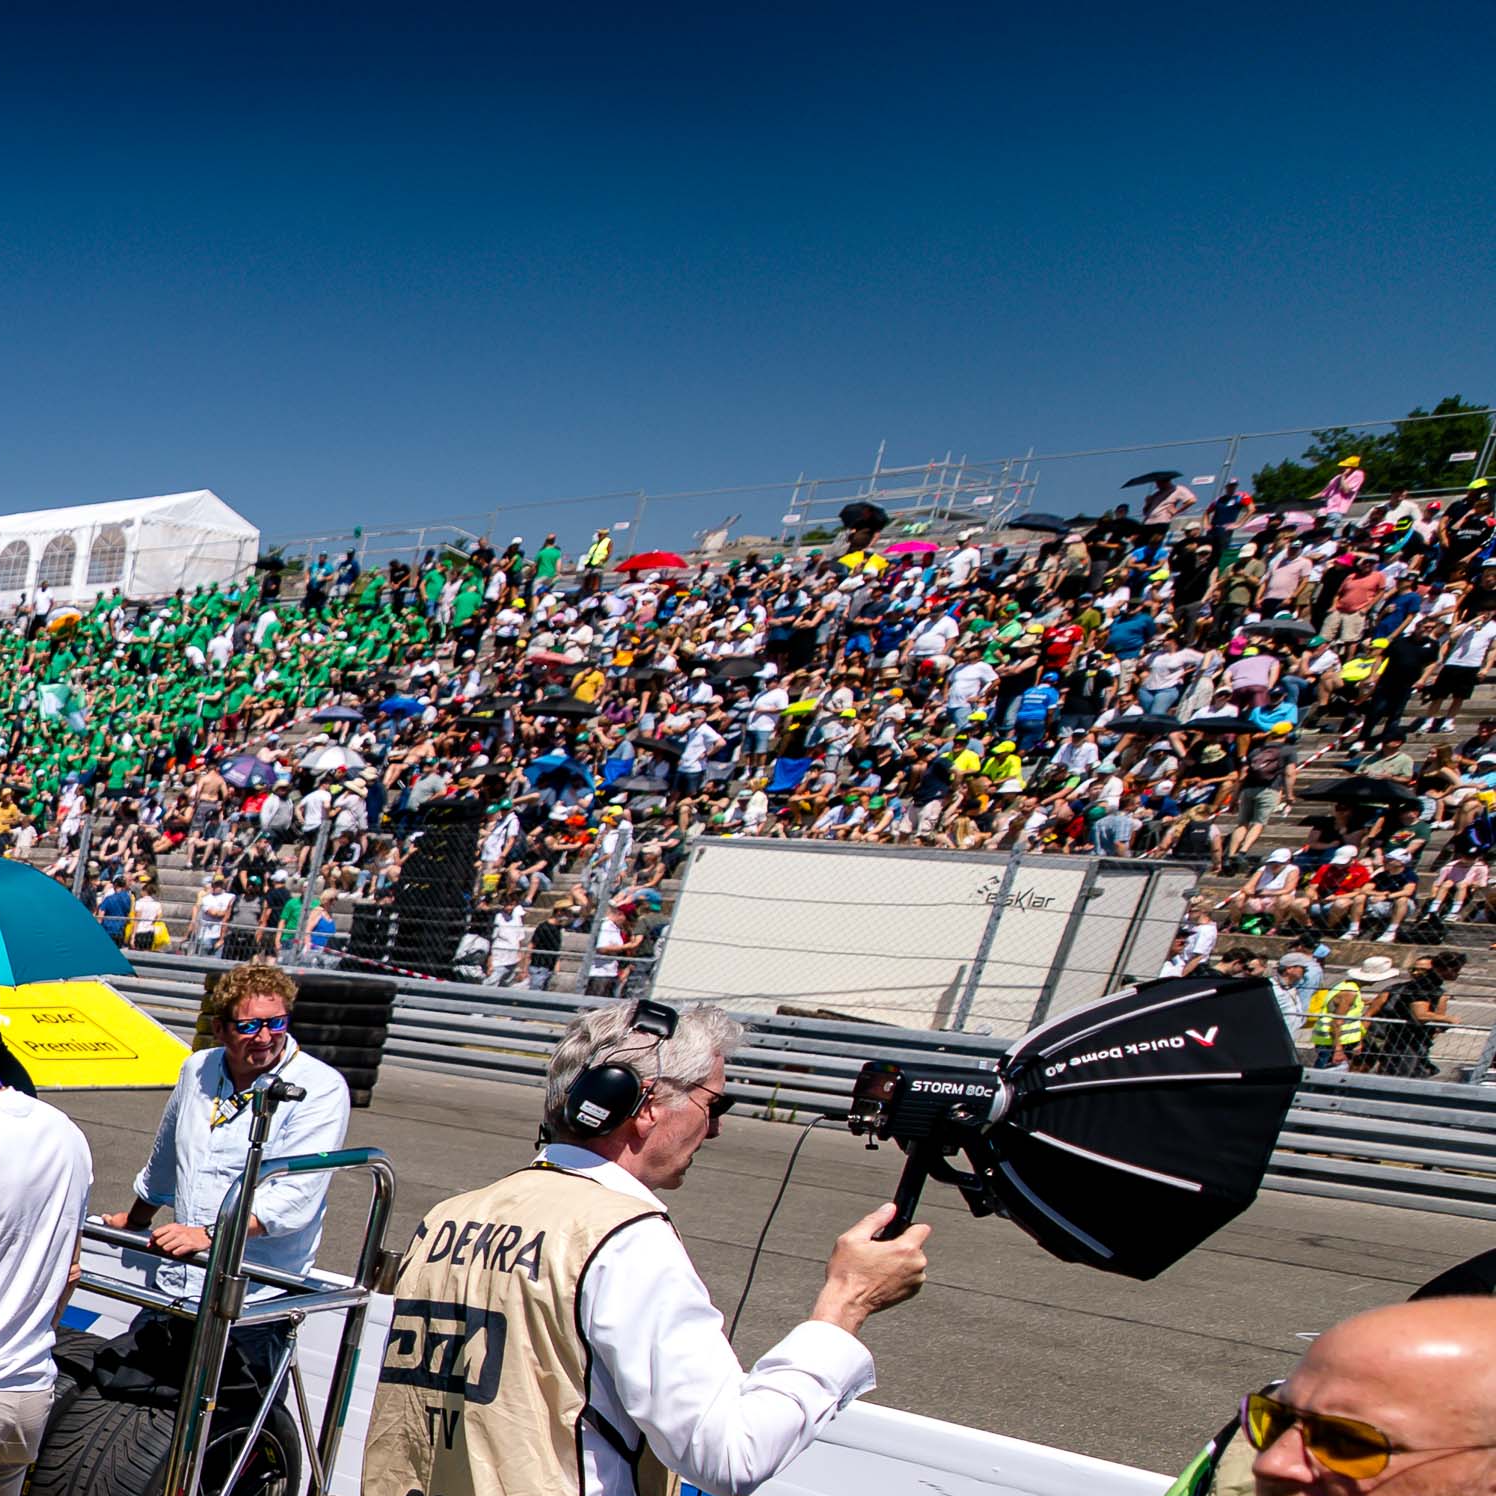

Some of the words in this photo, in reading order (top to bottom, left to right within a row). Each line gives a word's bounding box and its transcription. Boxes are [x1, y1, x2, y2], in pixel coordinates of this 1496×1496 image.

[31, 1012, 85, 1026] ADAC
[24, 1038, 120, 1054] Premium
[1068, 1046, 1123, 1066] Dome
[1045, 1063, 1068, 1077] 40
[910, 1080, 964, 1096] STORM
[426, 1220, 546, 1282] DEKRA
[425, 1406, 460, 1450] TV
